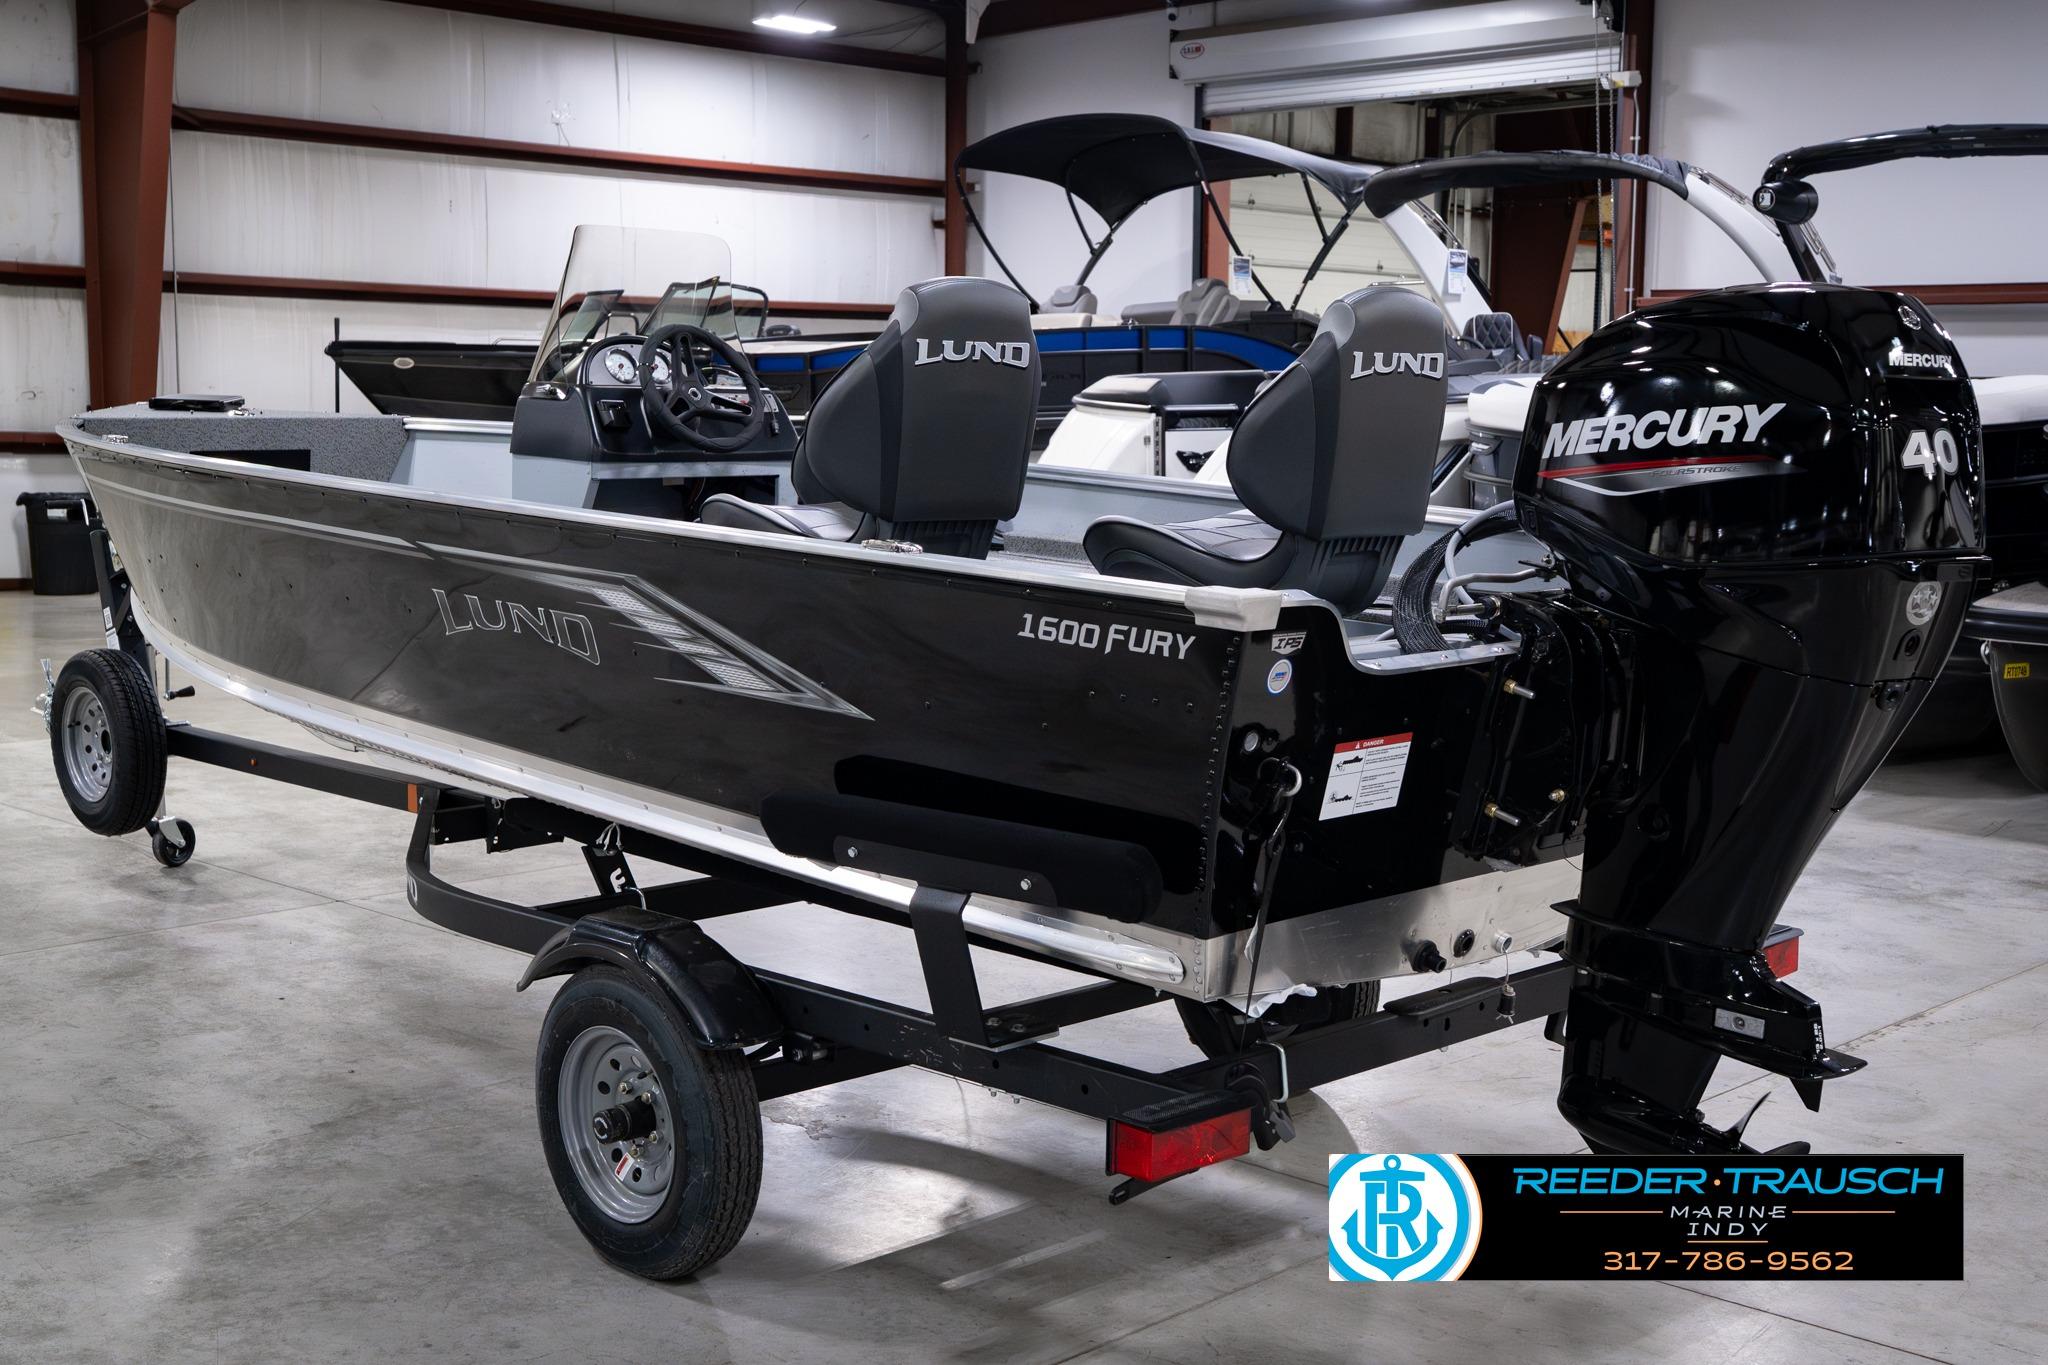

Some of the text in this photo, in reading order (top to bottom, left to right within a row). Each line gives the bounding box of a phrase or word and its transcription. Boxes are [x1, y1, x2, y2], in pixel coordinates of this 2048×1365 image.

[915, 338, 1030, 368] LUND
[1350, 351, 1444, 379] LUND
[1888, 352, 1953, 368] MERCURY
[1542, 403, 1787, 459] MERCURY
[1900, 428, 1959, 477] 40
[432, 588, 600, 665] LUND
[1017, 613, 1197, 660] 1600 FURY
[1274, 637, 1303, 650] IPS
[1362, 739, 1385, 748] DANGER
